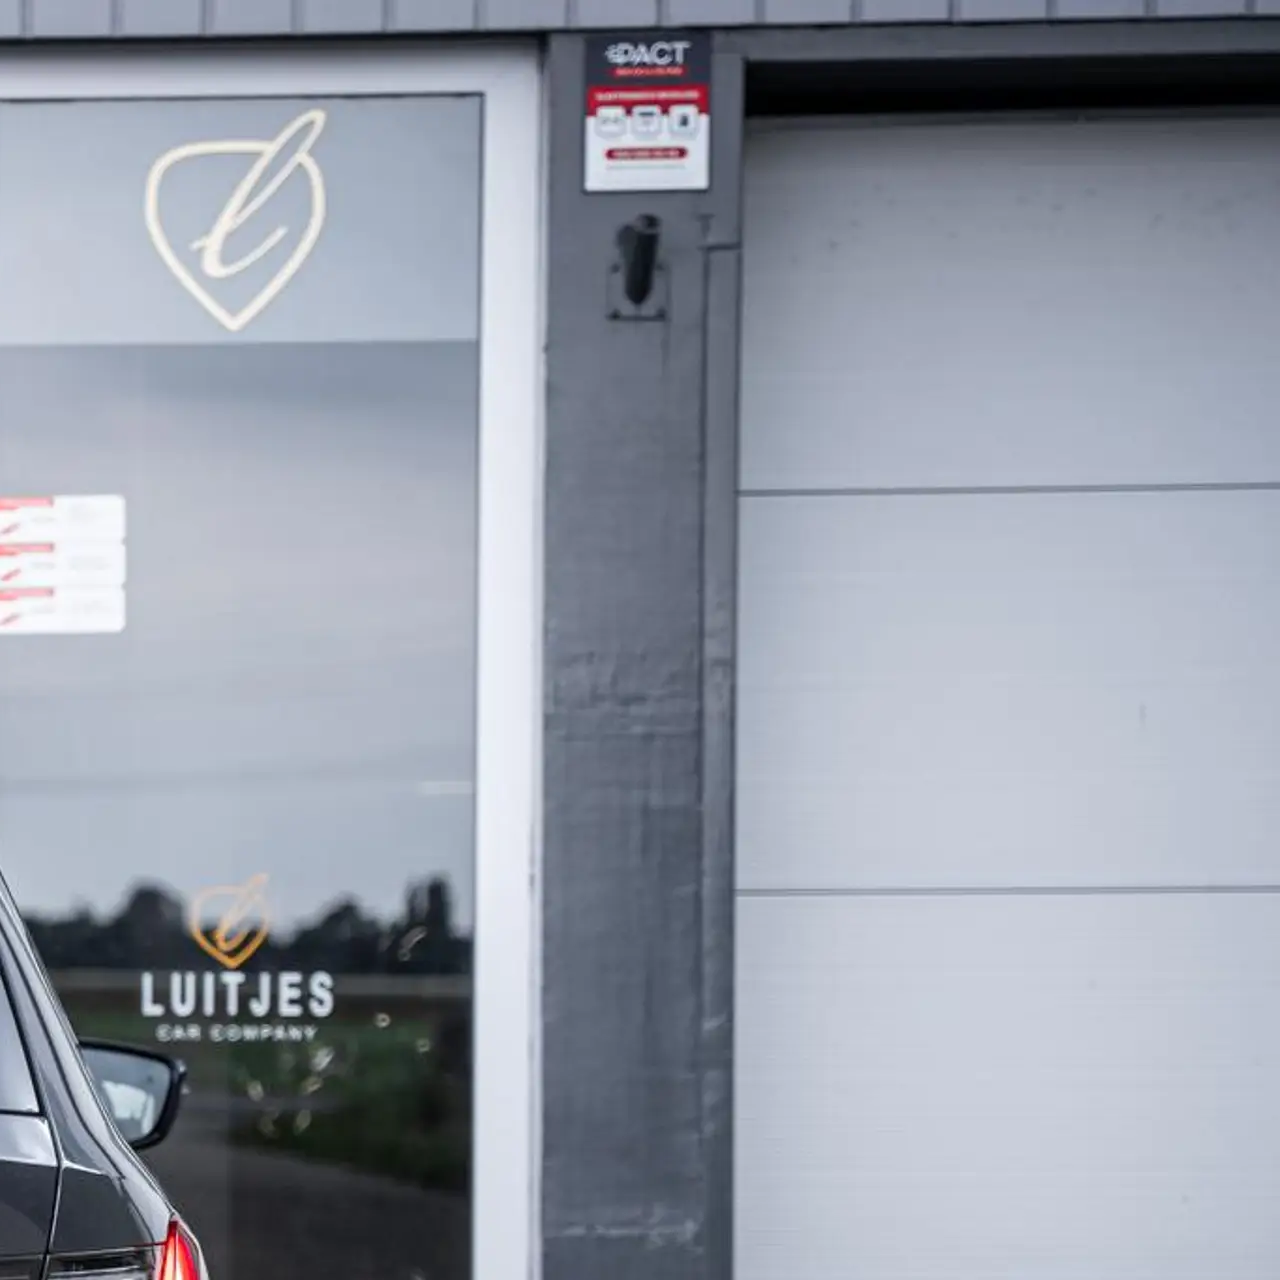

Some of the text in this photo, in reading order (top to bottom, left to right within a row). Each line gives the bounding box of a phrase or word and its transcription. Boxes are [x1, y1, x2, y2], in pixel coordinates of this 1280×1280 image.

[141, 971, 335, 1018] LUITJES
[155, 1024, 319, 1042] CAR COMPANY
